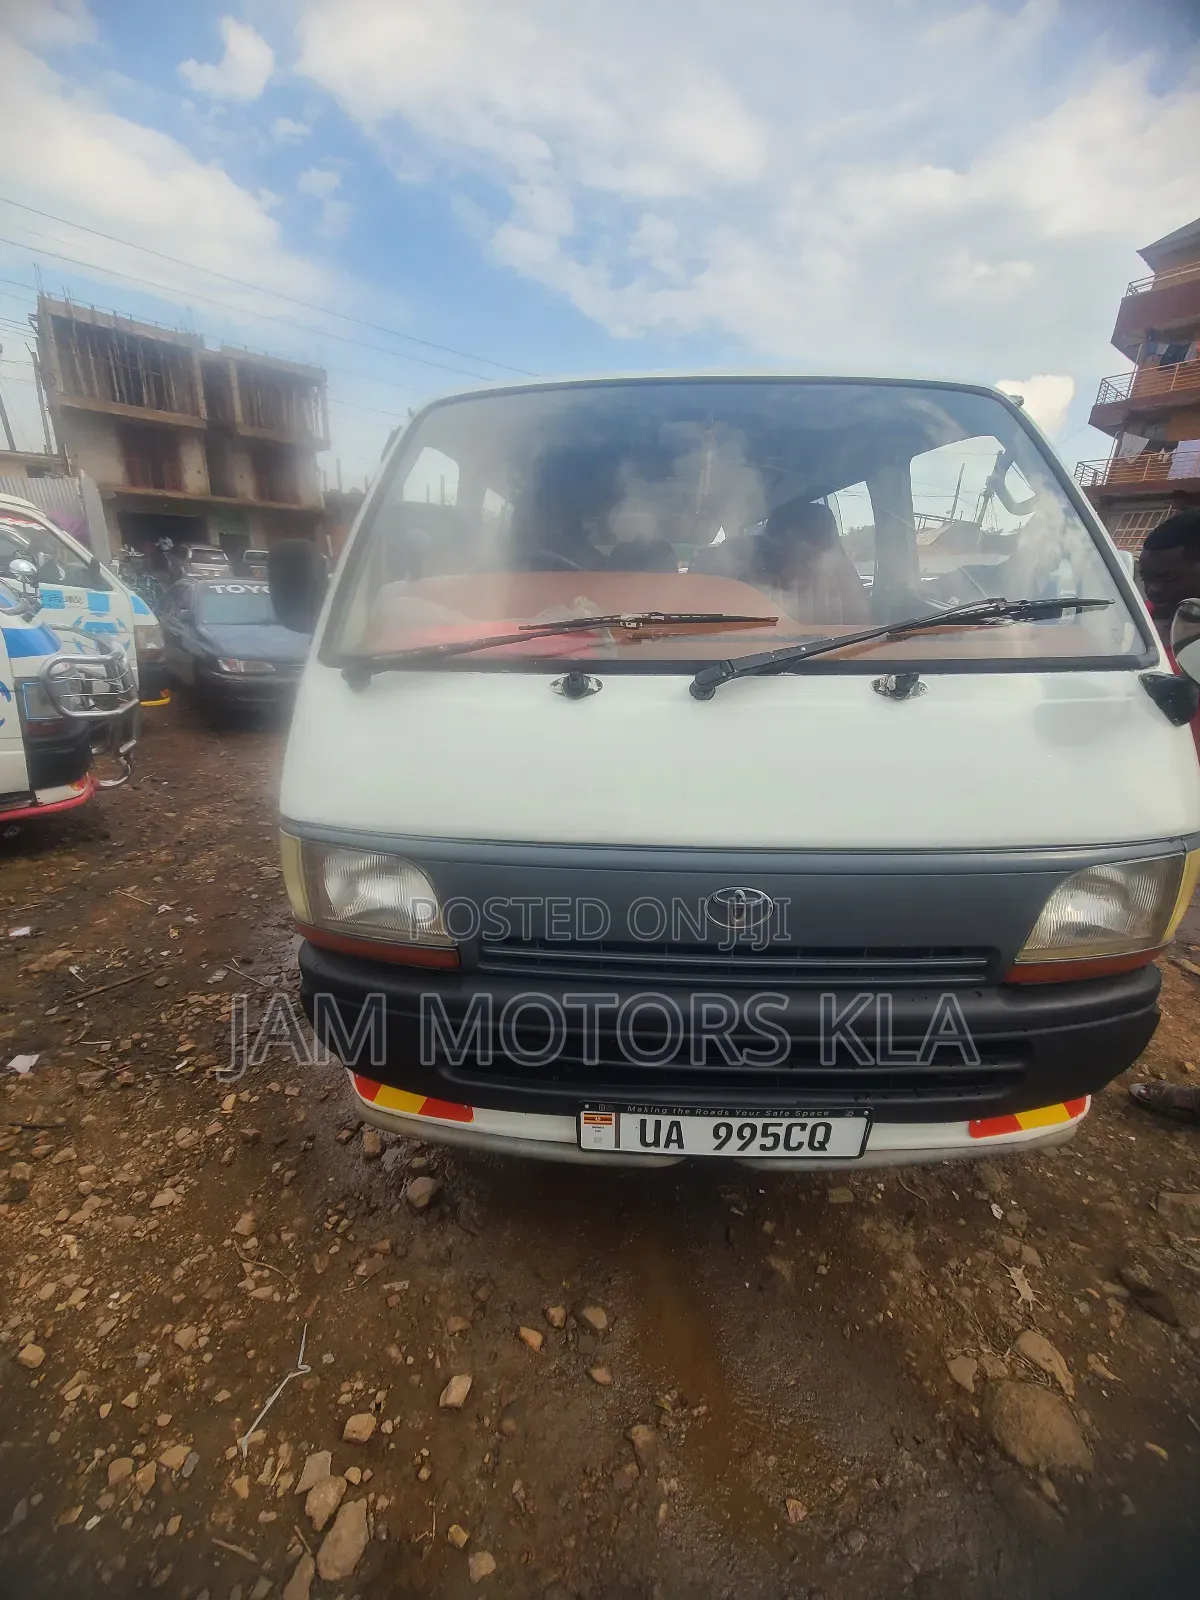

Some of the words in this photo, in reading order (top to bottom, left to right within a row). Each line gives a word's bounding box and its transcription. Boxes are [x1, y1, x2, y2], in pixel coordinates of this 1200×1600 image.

[627, 1105, 668, 1115] Making
[673, 1107, 690, 1115] the
[695, 1107, 729, 1116] Roads
[795, 1110, 829, 1118] Space
[639, 1118, 685, 1150] UA
[712, 1121, 832, 1152] 995CQ
